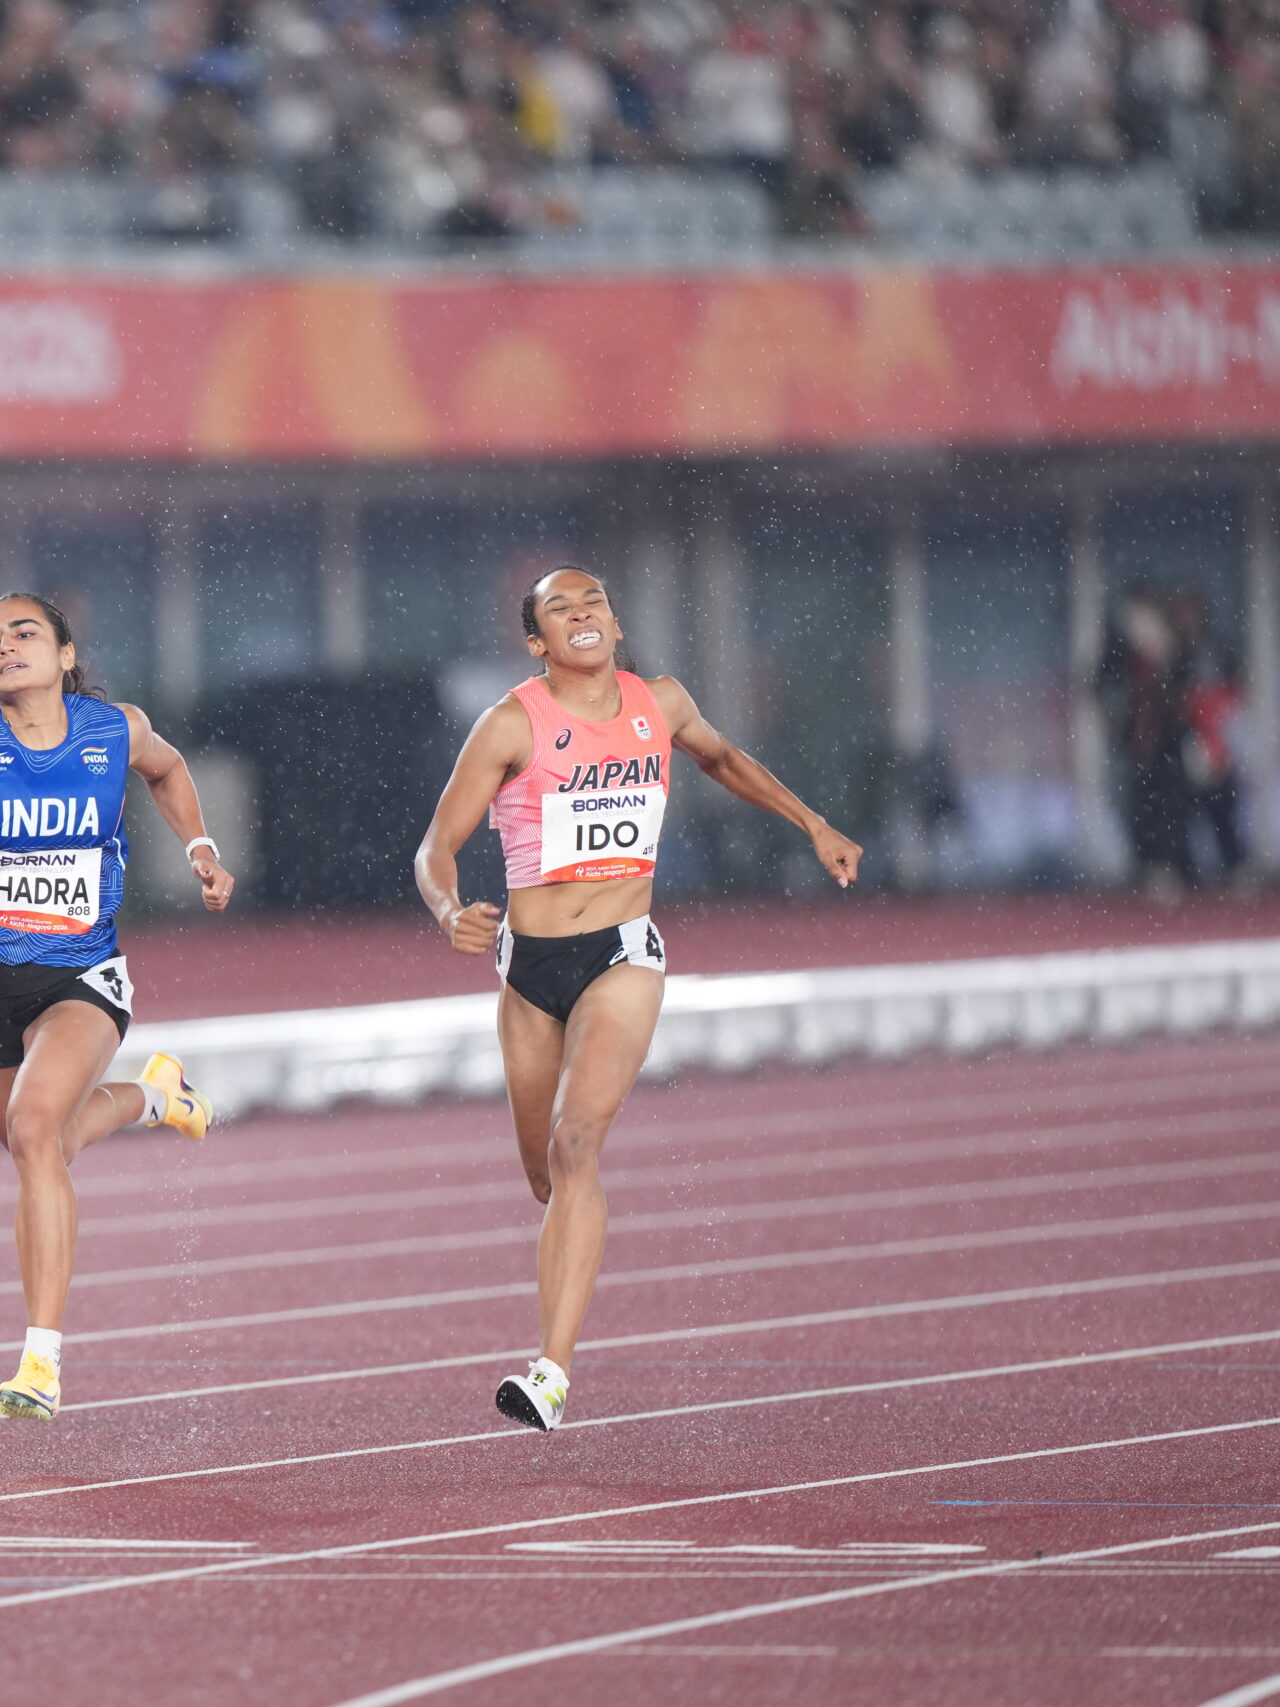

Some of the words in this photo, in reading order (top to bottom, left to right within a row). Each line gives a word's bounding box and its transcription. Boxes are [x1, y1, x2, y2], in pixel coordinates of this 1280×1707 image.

[82, 754, 108, 765] INDIA
[557, 754, 661, 793] JAPAN
[571, 795, 646, 812] BORNAN
[1, 797, 99, 837] INDIA
[576, 820, 639, 851] IDO
[0, 854, 76, 867] BORNAN
[67, 906, 91, 916] 808
[9, 920, 52, 932] Aichi-Nagoya
